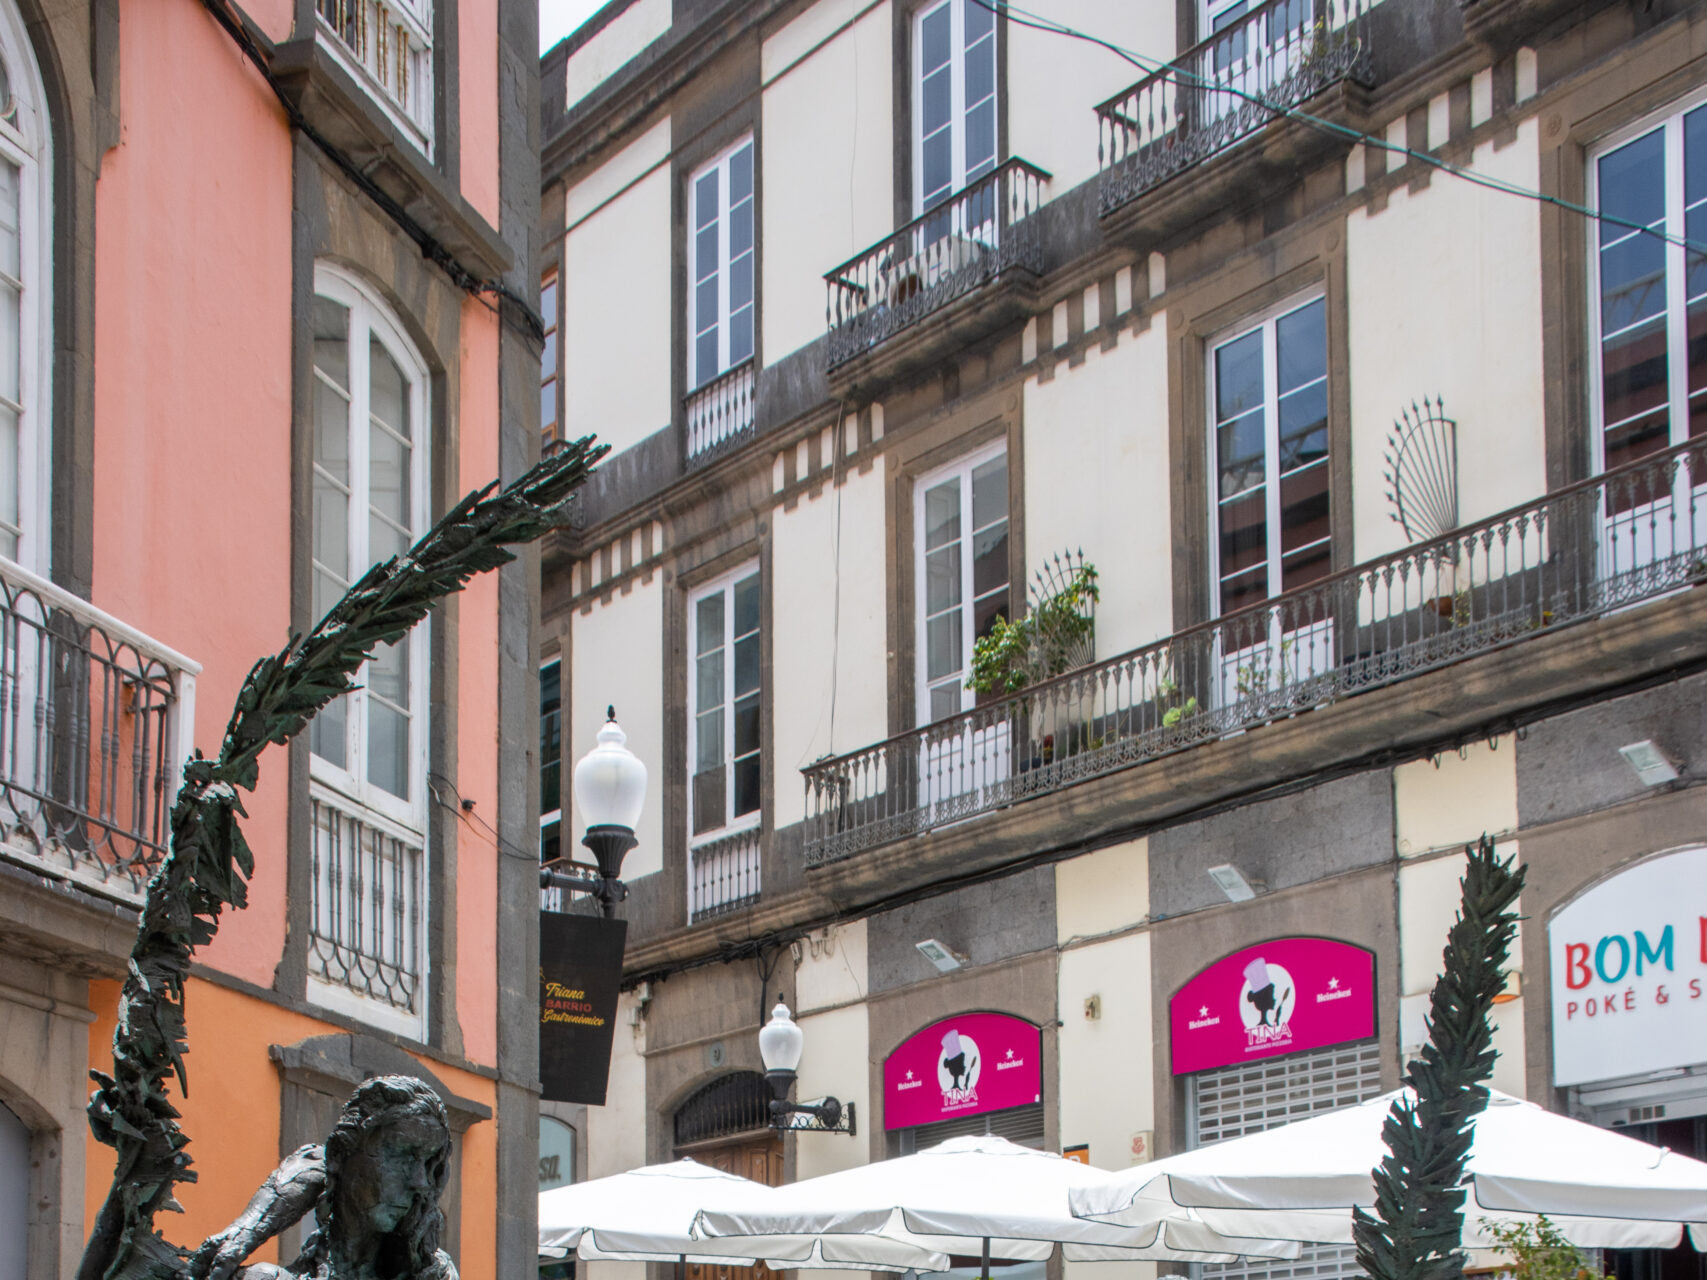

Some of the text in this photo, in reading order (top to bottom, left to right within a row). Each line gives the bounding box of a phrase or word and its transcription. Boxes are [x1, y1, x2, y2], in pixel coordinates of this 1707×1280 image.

[1565, 924, 1675, 990] BOM
[546, 982, 585, 999] Triana
[1316, 989, 1352, 1003] Heineken
[545, 999, 592, 1013] BARRIO
[1567, 986, 1636, 1021] POKÉ
[1655, 984, 1669, 1005] &
[1189, 1017, 1220, 1030] Heineken
[1244, 1022, 1292, 1046] TINA
[997, 1059, 1023, 1070] Heineken
[898, 1080, 922, 1091] Heineken
[941, 1086, 978, 1106] TINA
